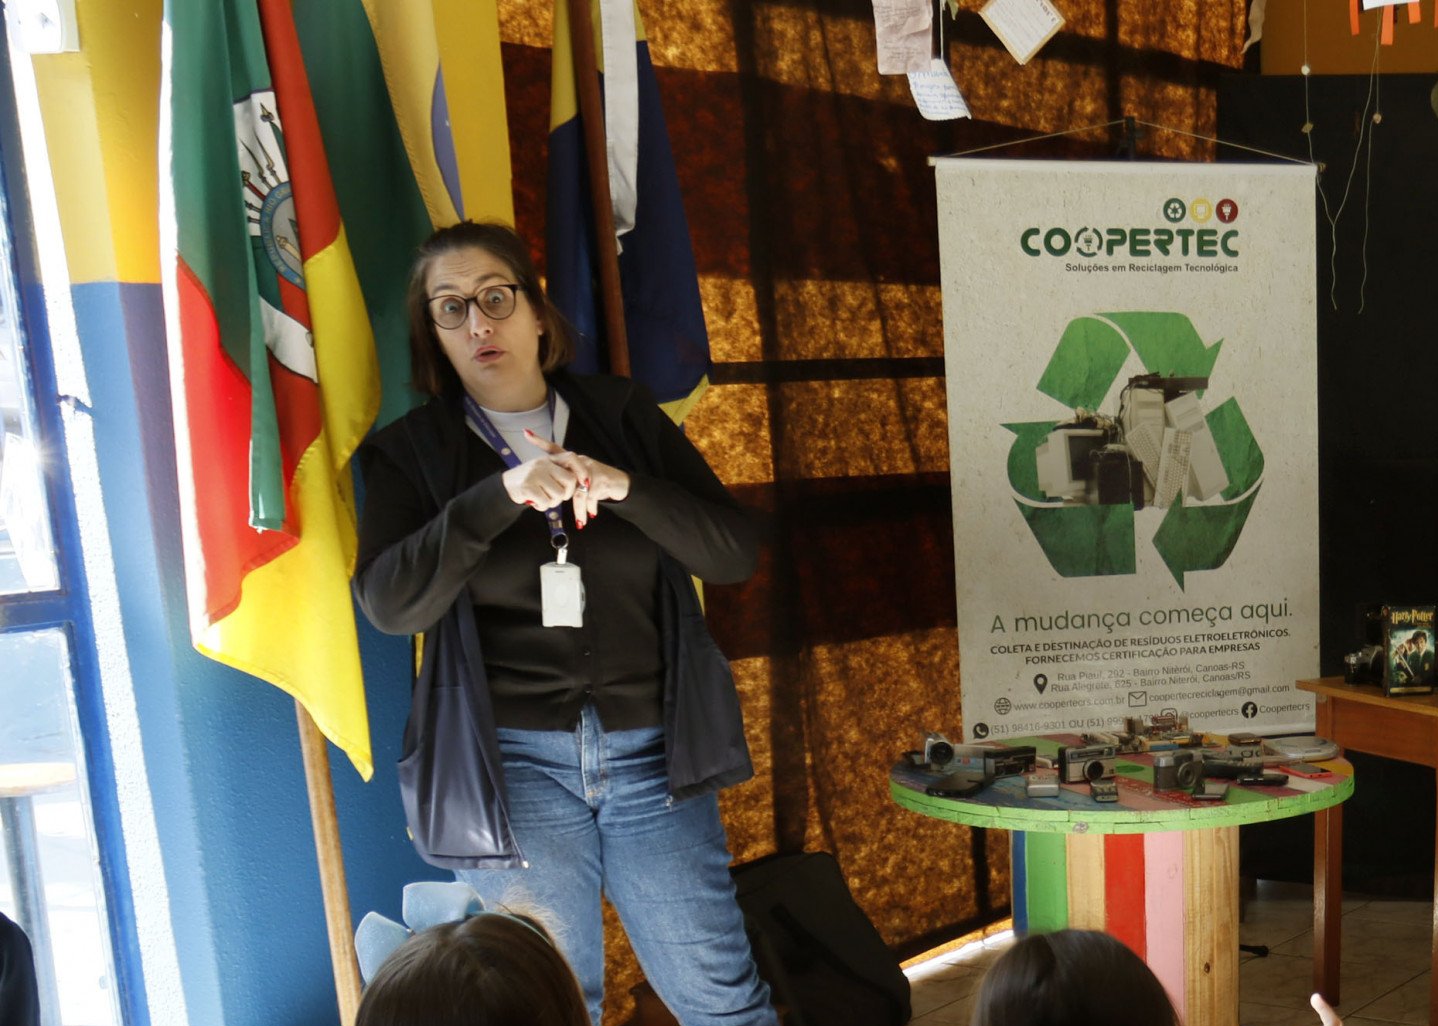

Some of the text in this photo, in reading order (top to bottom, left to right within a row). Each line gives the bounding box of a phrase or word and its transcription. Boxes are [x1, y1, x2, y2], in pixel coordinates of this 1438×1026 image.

[1020, 226, 1239, 257] COOPERTEC
[1065, 263, 1109, 273] Soluções
[1129, 263, 1182, 273] Reciclagem
[1185, 263, 1239, 273] Tecnológica
[991, 597, 1293, 634] A mudança começa aqui.
[1392, 609, 1434, 624] Harry Potter
[990, 628, 1291, 655] COLETA E DESTINAÇÃO DE RESÍDUOS ELETROELETRÔNICOS.
[1026, 642, 1261, 665] FORNECEMOS CERTIFICAÇÃO PARA EMPRESAS
[1057, 672, 1076, 681] Rua
[1107, 669, 1125, 679] 292
[1133, 668, 1160, 678] Bairro
[1196, 661, 1245, 673] Canoas-RS
[1051, 683, 1070, 692] Rua
[1115, 679, 1132, 689] 625
[1140, 677, 1167, 687] Bairro
[1202, 671, 1251, 683] Canoas/RS
[1149, 684, 1290, 702] coopertecreciclagem@gmail.com
[1014, 696, 1125, 711] www.coopertecrs.com.br
[1259, 702, 1310, 715] Coopertecrs
[990, 723, 1009, 735] (51)
[1069, 718, 1084, 729] OU
[1087, 717, 1105, 729] (51)
